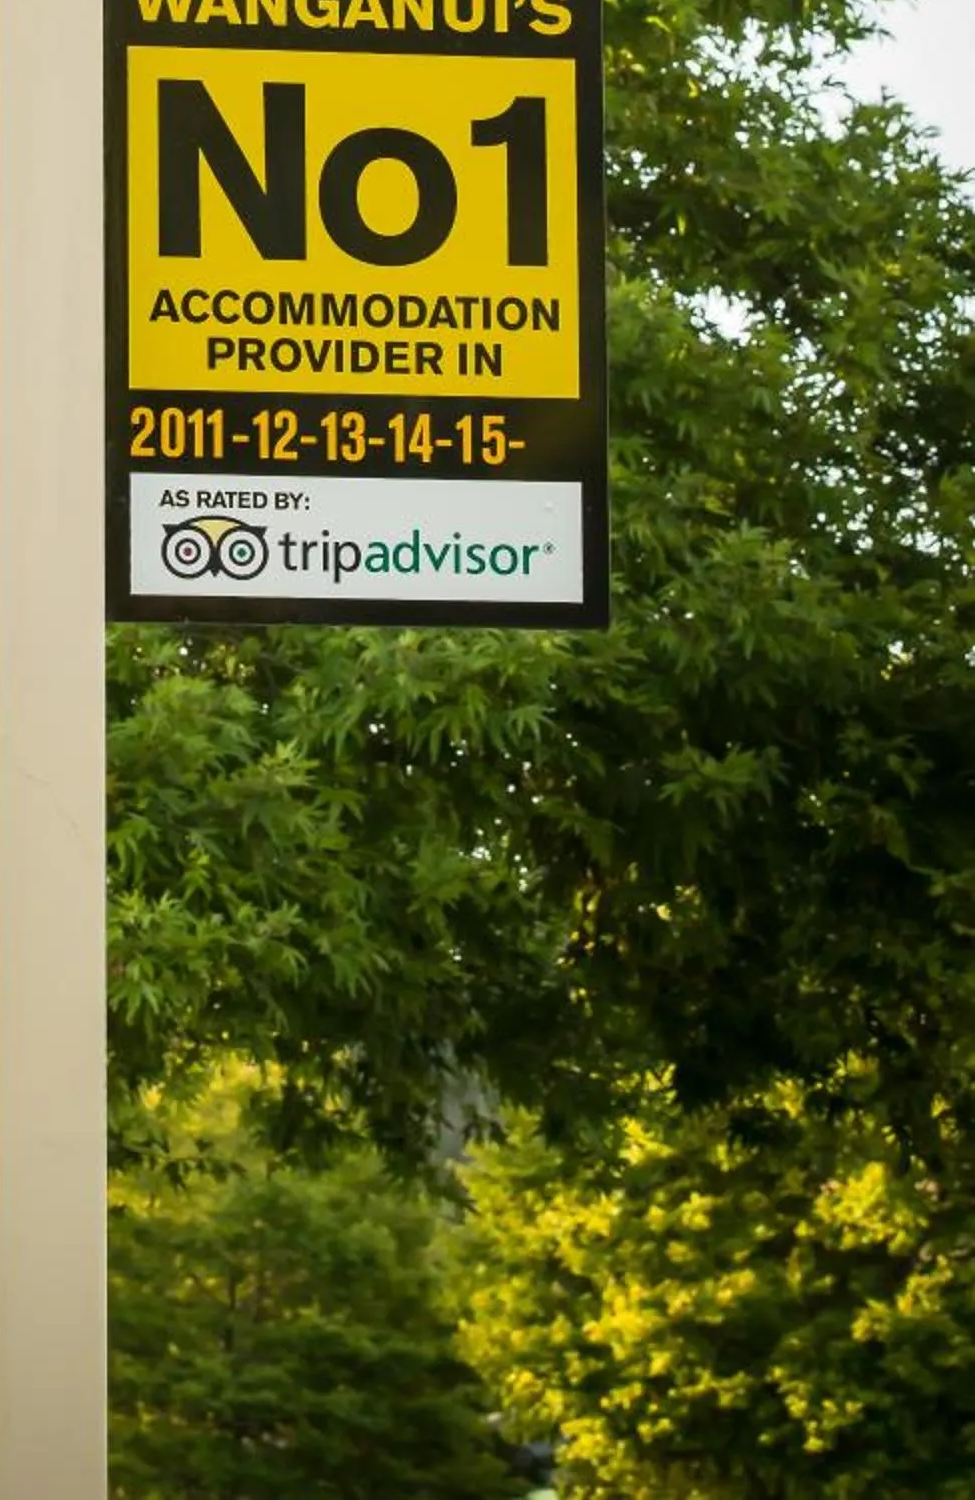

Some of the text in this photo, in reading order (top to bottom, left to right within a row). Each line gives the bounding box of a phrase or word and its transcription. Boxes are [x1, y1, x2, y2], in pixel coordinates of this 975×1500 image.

[157, 78, 549, 268] No1
[149, 288, 561, 332] ACCOMMODATION
[207, 337, 503, 377] PROVIDER IN
[159, 490, 311, 511] AS RATED BY:
